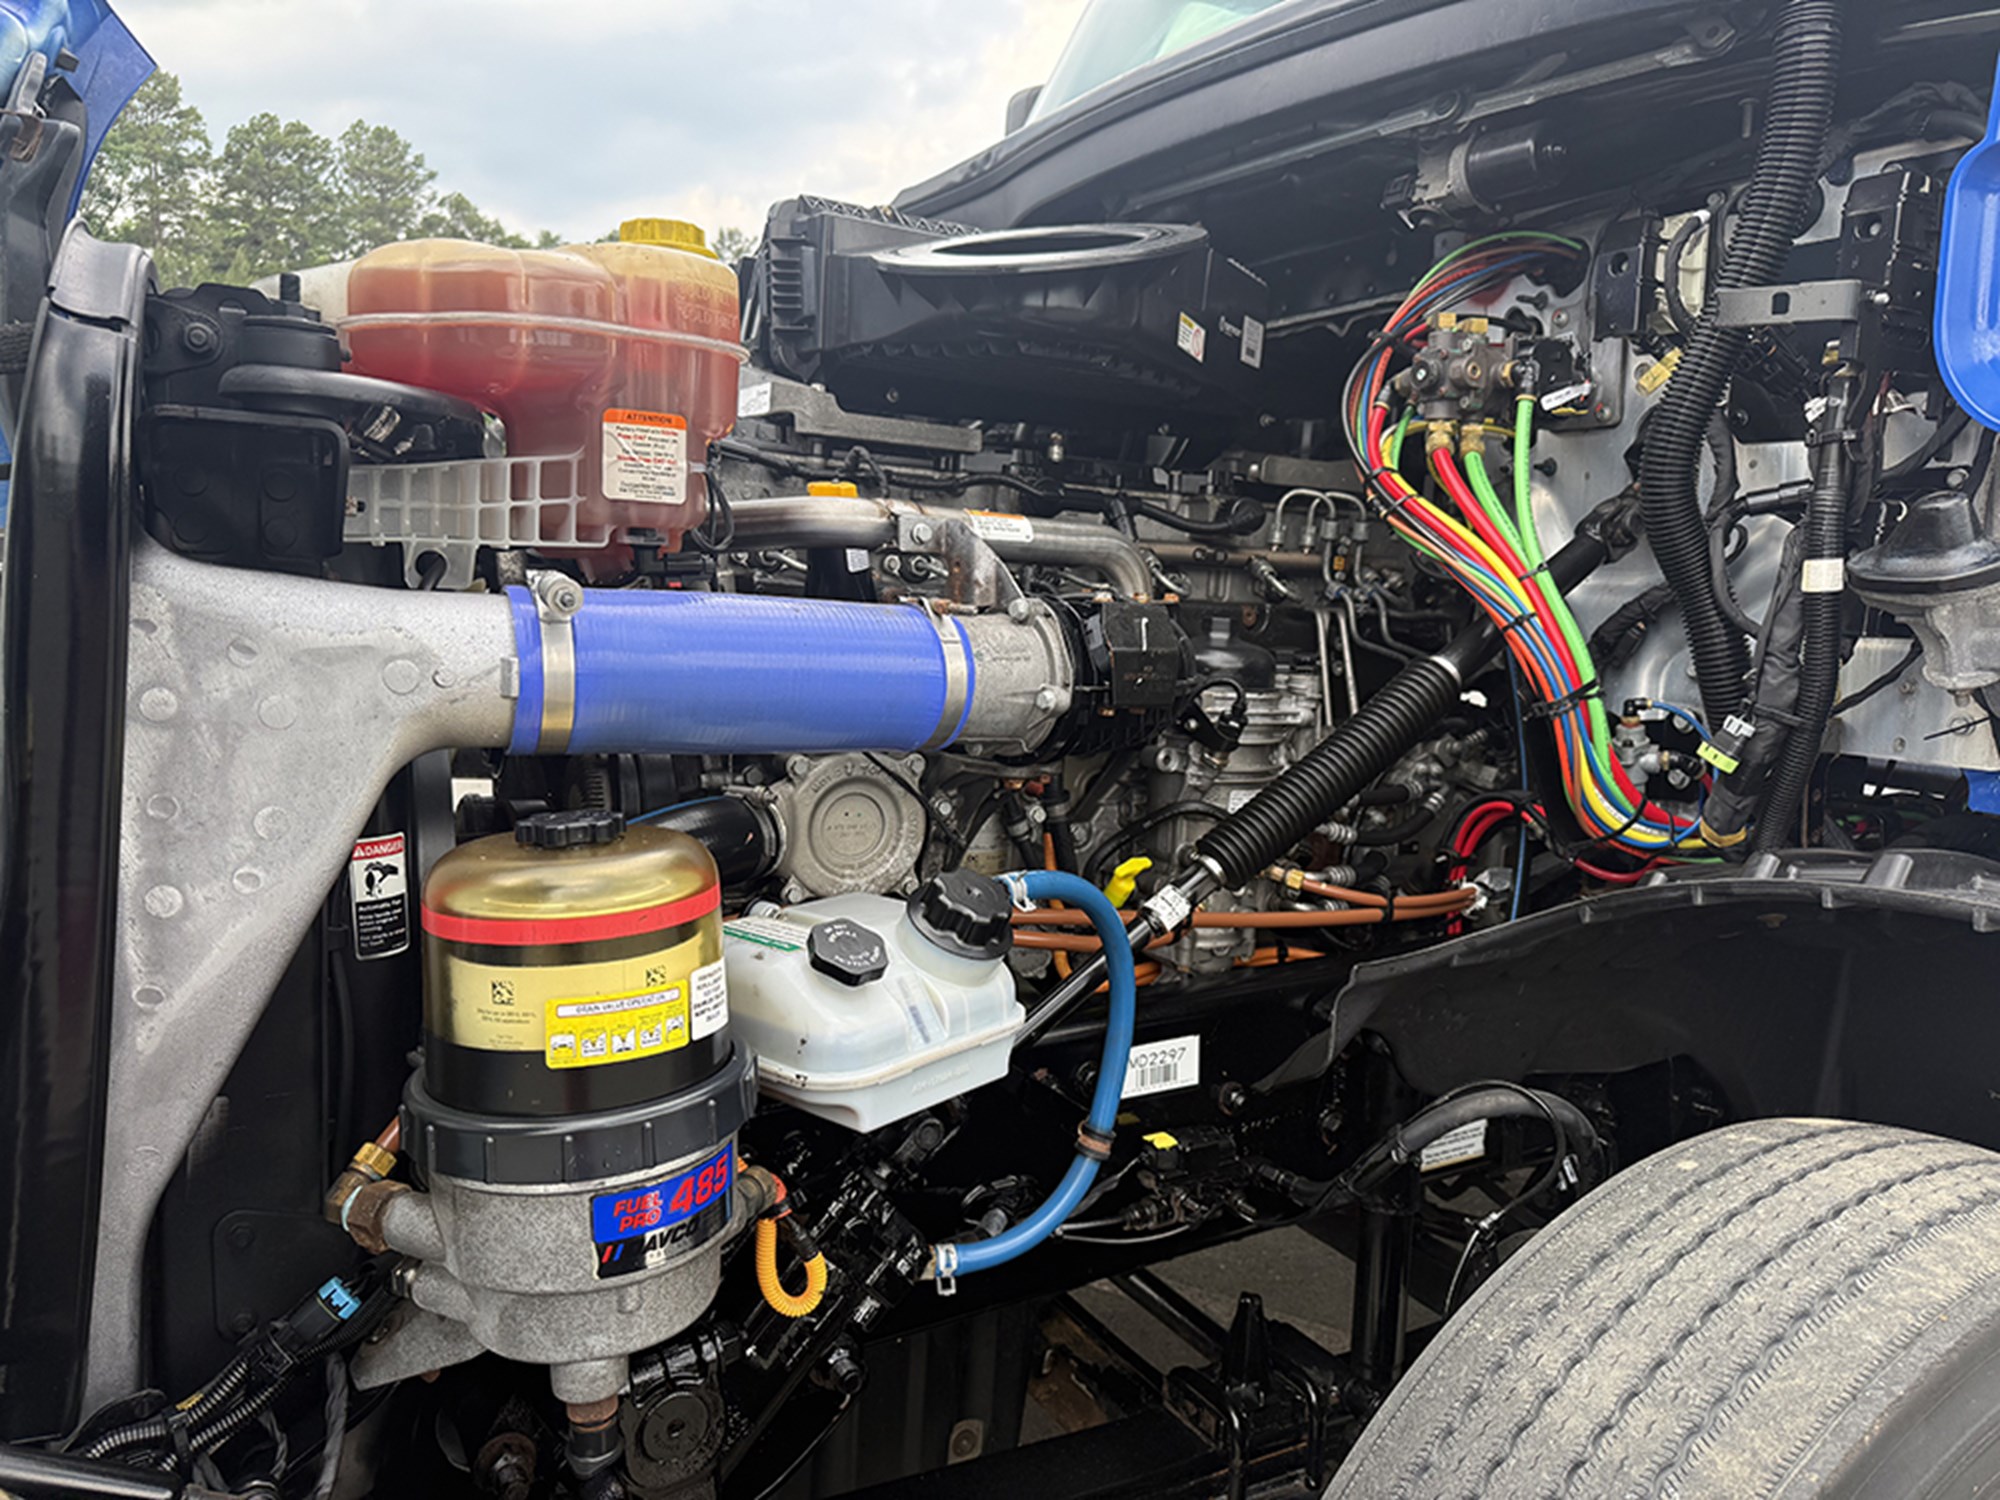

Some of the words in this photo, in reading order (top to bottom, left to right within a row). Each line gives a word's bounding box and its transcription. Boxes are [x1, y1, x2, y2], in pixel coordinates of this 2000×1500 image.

[626, 413, 672, 424] ATTENTION
[365, 840, 403, 857] DANGER
[613, 1190, 663, 1217] FUEL
[669, 1153, 728, 1214] 485
[619, 1208, 661, 1233] PRO
